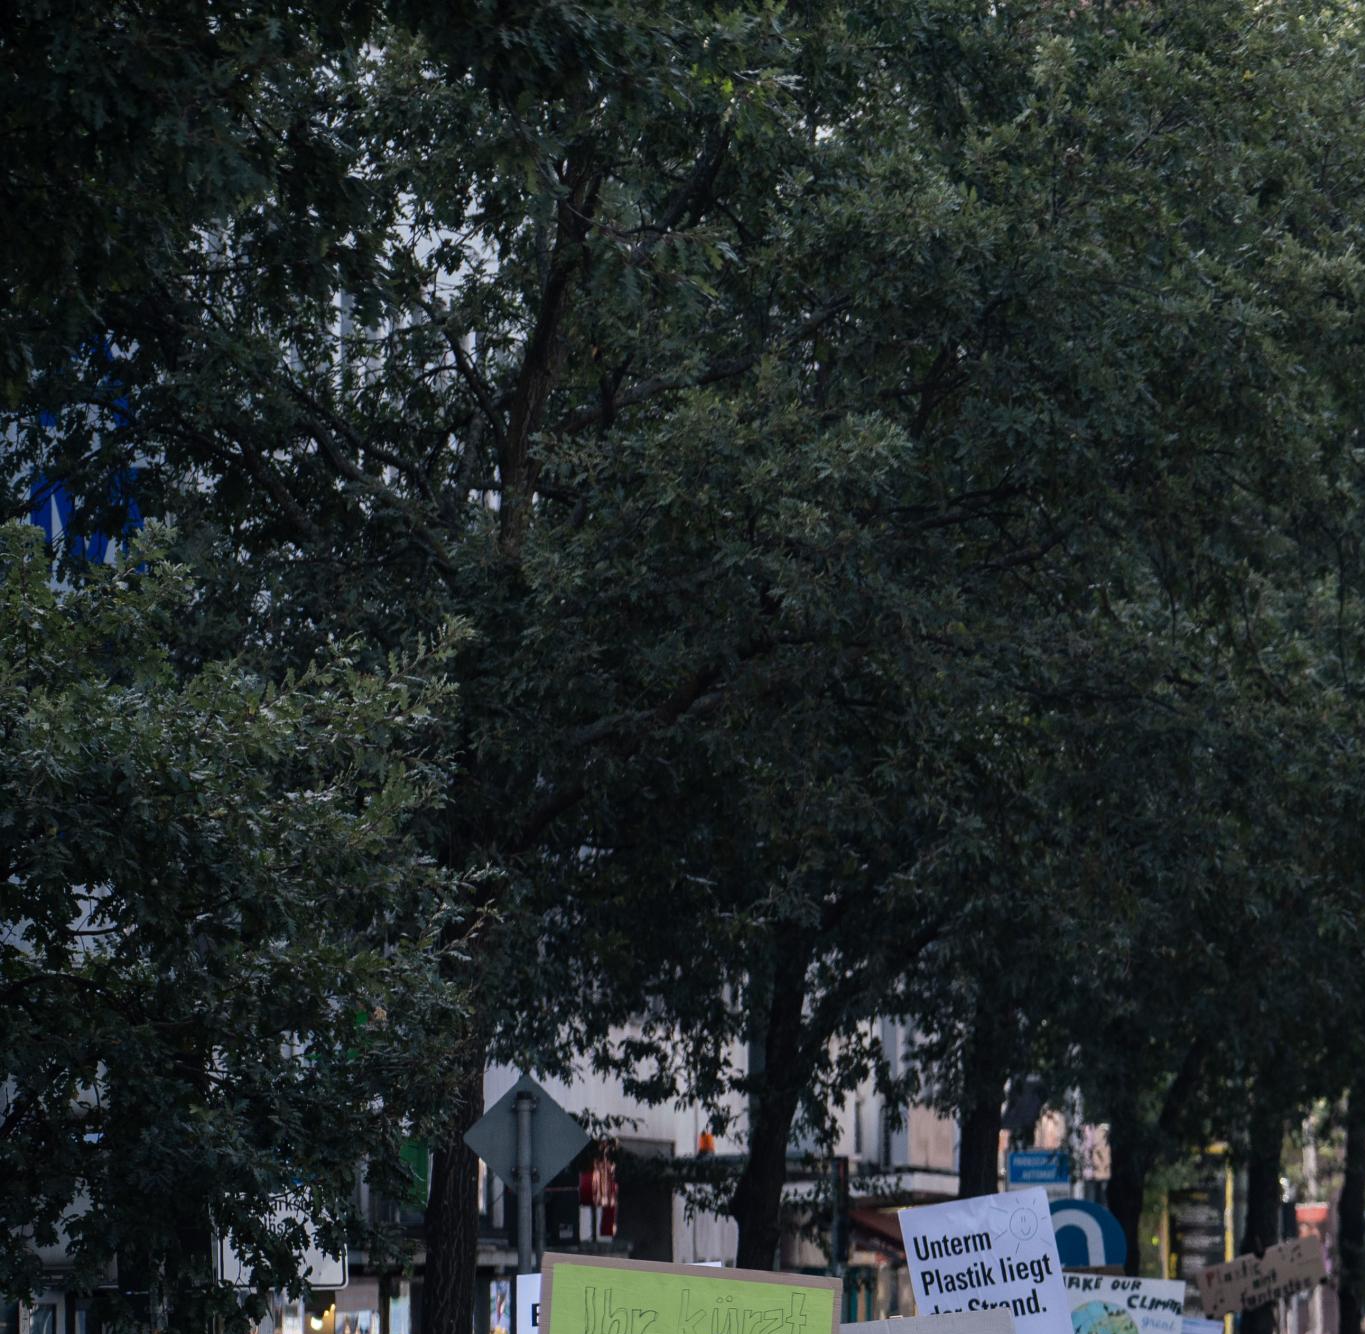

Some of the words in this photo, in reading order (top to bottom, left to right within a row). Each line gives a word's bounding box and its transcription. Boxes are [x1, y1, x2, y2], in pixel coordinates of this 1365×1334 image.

[913, 1232, 992, 1261] Unterm
[921, 1262, 996, 1296] Plastik
[999, 1254, 1053, 1284] liegt
[1111, 1279, 1141, 1291] OUR
